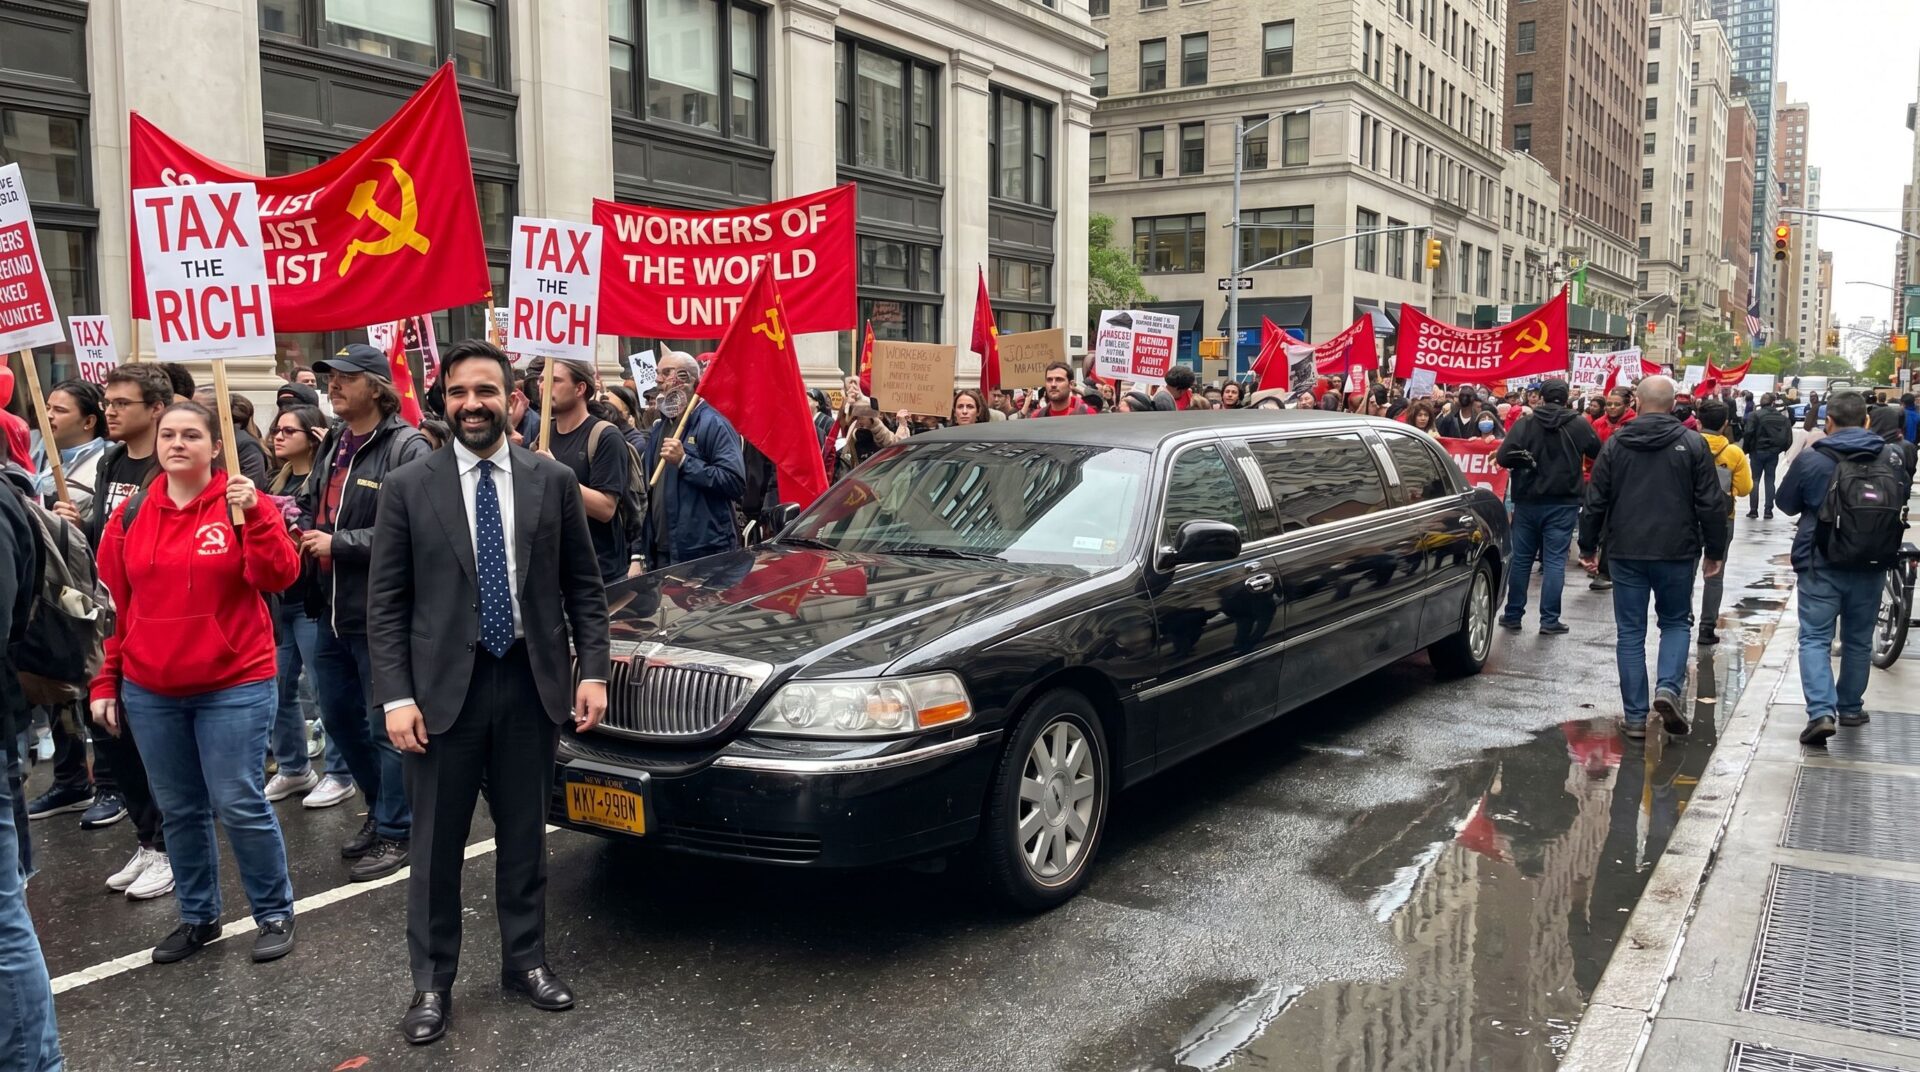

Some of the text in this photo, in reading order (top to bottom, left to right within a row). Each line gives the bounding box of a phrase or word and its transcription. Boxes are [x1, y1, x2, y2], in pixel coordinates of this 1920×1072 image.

[145, 192, 249, 253] TAX
[613, 204, 827, 246] WORKERS OF
[520, 225, 592, 276] TAX
[181, 258, 225, 279] THE
[623, 254, 685, 286] THE
[537, 278, 568, 296] THE
[155, 284, 266, 343] RICH
[513, 296, 591, 347] RICH
[72, 320, 109, 347] TAX
[1417, 336, 1503, 355] SOCIALIST
[87, 349, 104, 359] THE
[1414, 351, 1503, 369] SOCIALIST
[1577, 355, 1602, 369] TAX
[584, 775, 624, 789] NEW YORK
